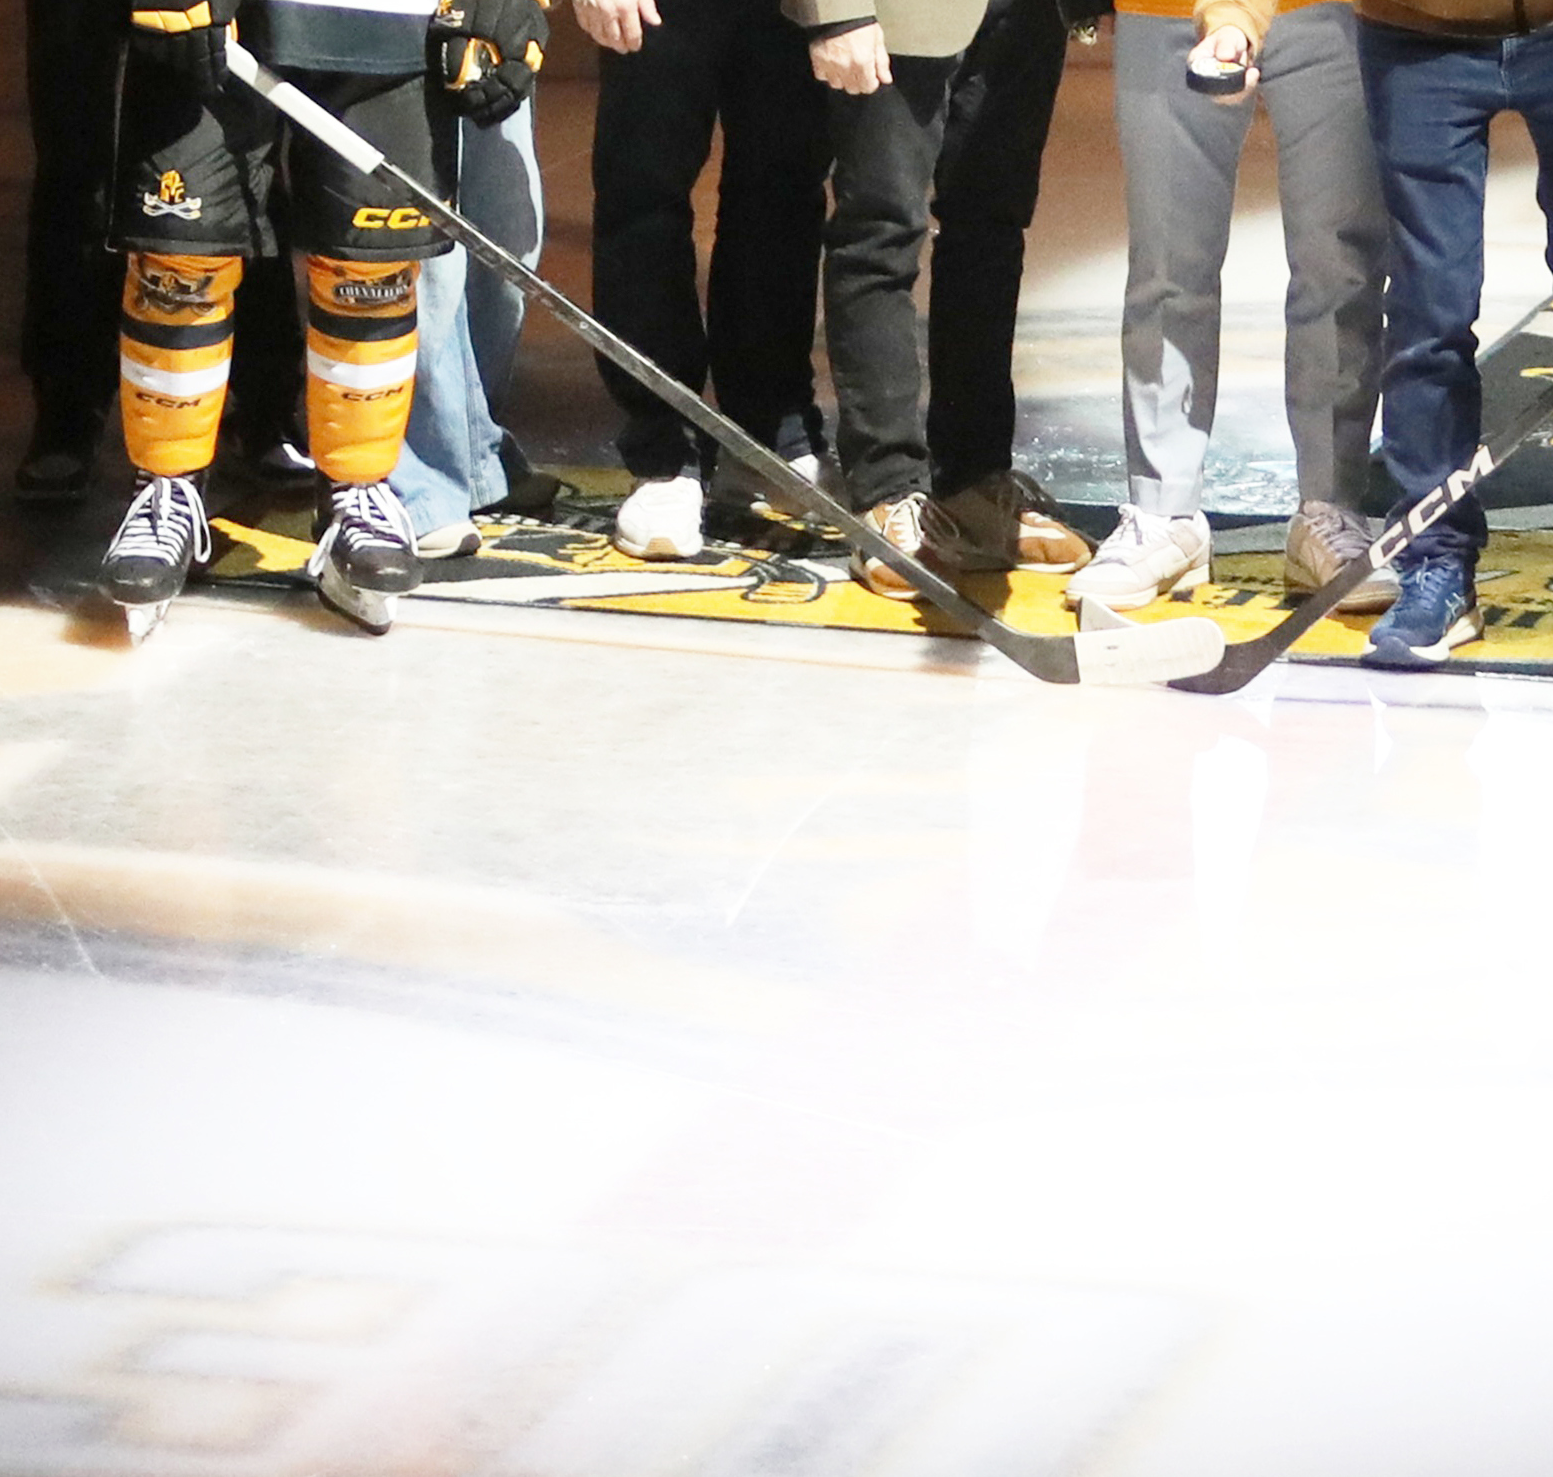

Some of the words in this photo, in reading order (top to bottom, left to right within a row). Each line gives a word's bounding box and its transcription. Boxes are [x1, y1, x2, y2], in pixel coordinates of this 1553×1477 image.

[136, 391, 202, 410] CCM
[341, 386, 404, 403] CCM
[1368, 443, 1495, 570] CCM
